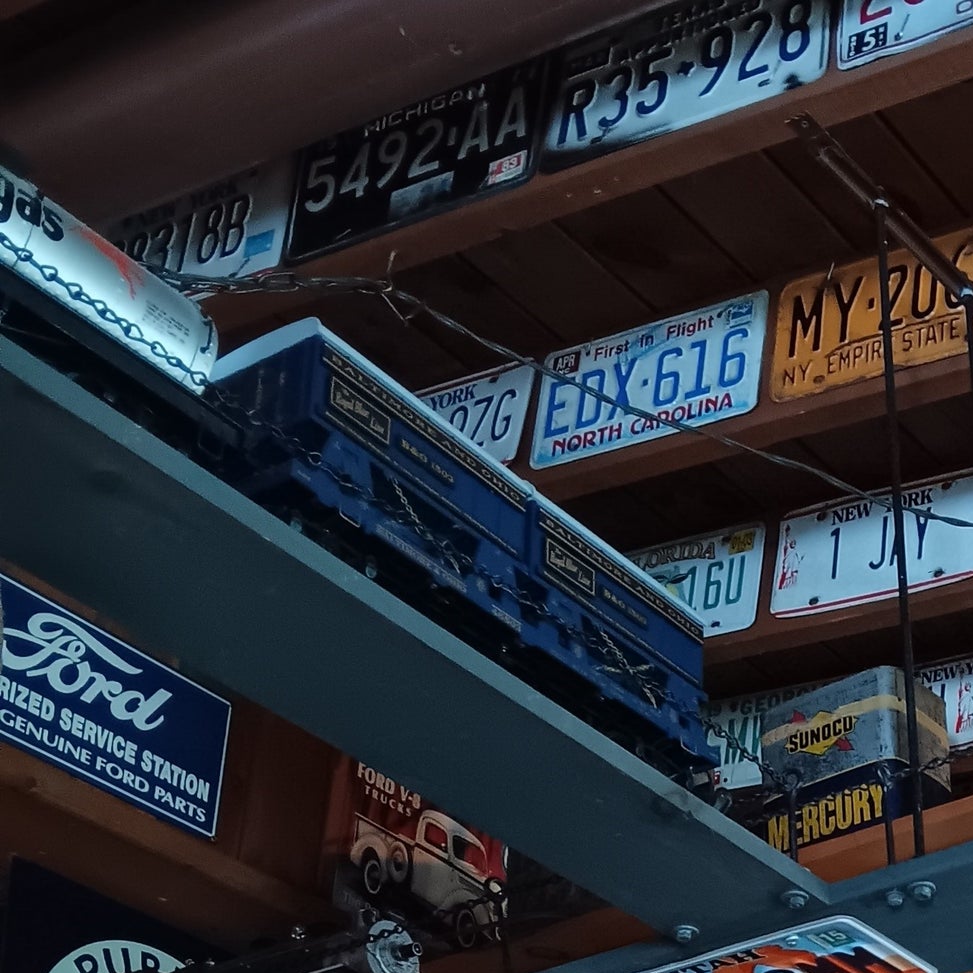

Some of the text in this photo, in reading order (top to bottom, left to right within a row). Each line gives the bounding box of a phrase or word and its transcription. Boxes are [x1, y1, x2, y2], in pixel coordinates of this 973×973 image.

[593, 314, 716, 362] First in Flight
[782, 317, 961, 387] NY STATE
[555, 353, 577, 373] APR
[550, 391, 734, 457] NORTH CAROLINA
[830, 501, 874, 526] NEW
[1, 612, 173, 731] Ford
[920, 661, 958, 684] NEW
[59, 707, 138, 765] SERVICE
[140, 749, 210, 803] STATION
[787, 715, 858, 752] SUNOCO
[0, 708, 207, 823] GENUINE FORD PARTS
[357, 761, 422, 811] FORD V-8
[364, 784, 413, 818] TRUCKS
[822, 928, 847, 944] 15
